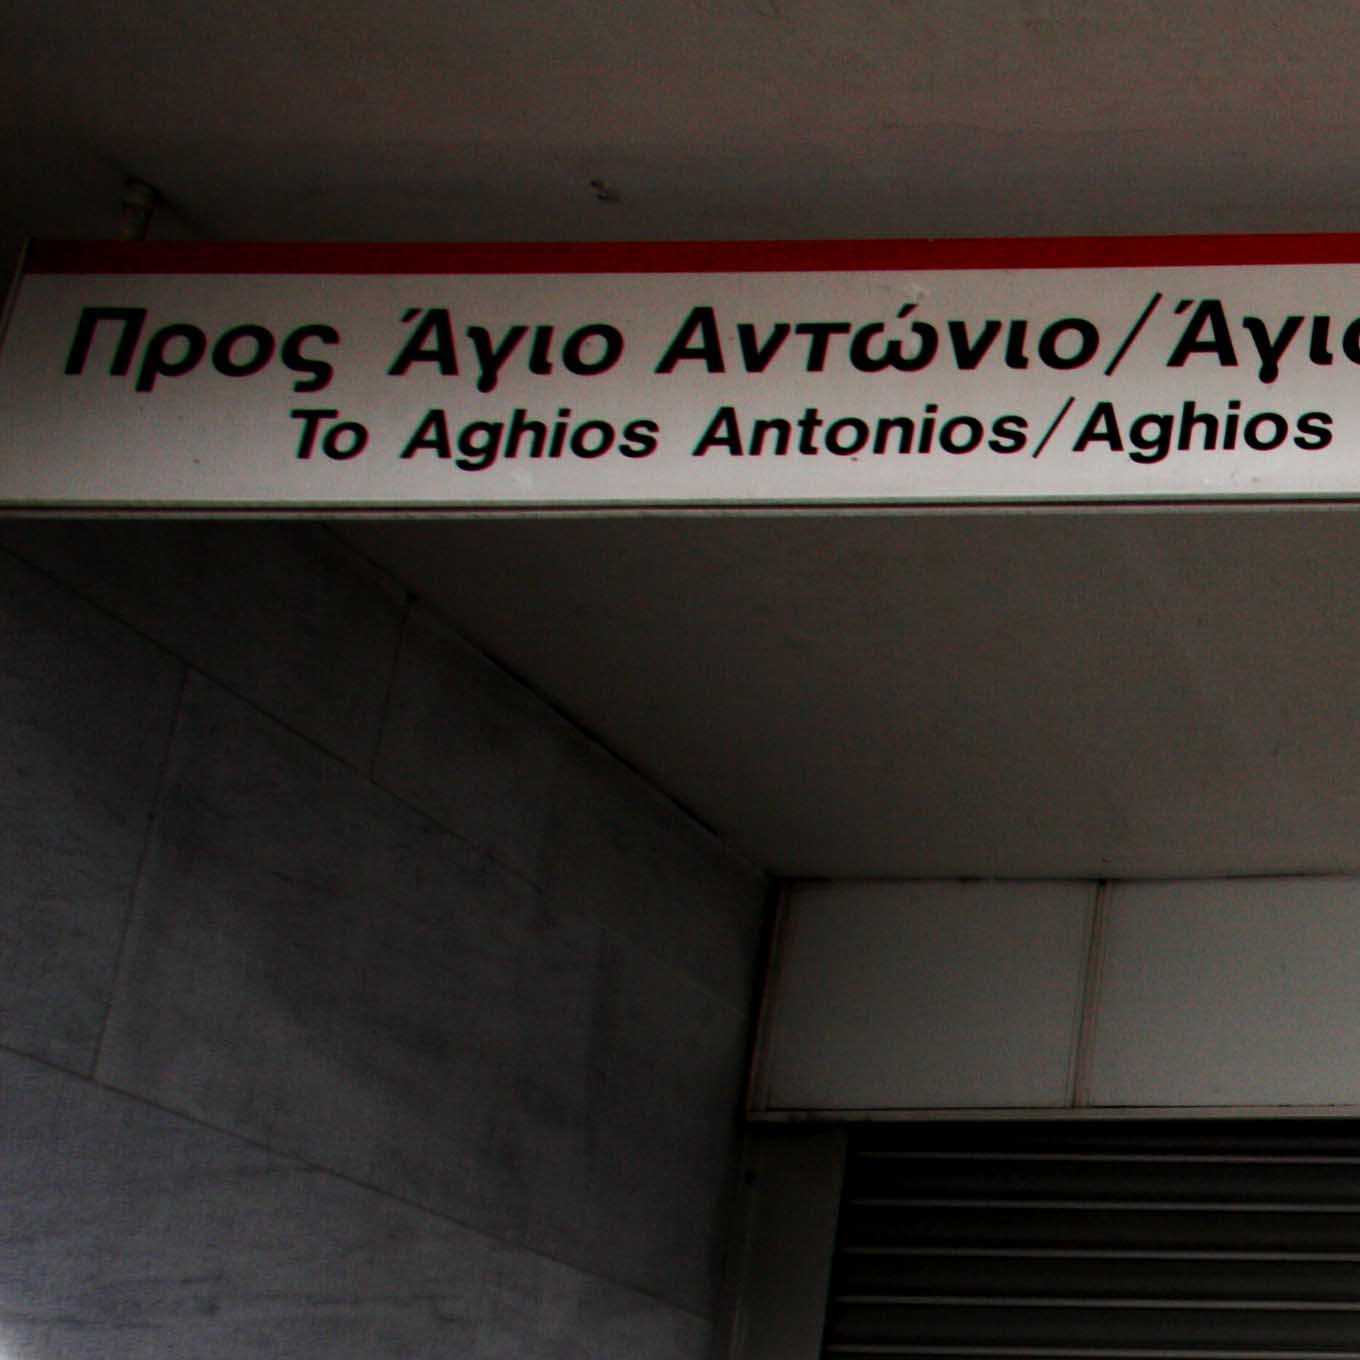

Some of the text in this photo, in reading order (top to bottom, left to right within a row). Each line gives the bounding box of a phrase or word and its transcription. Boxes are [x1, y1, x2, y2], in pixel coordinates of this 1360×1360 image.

[63, 305, 340, 393] Προς
[387, 307, 624, 394] Άγιο
[290, 408, 369, 461] To
[399, 407, 659, 472] Aghios
